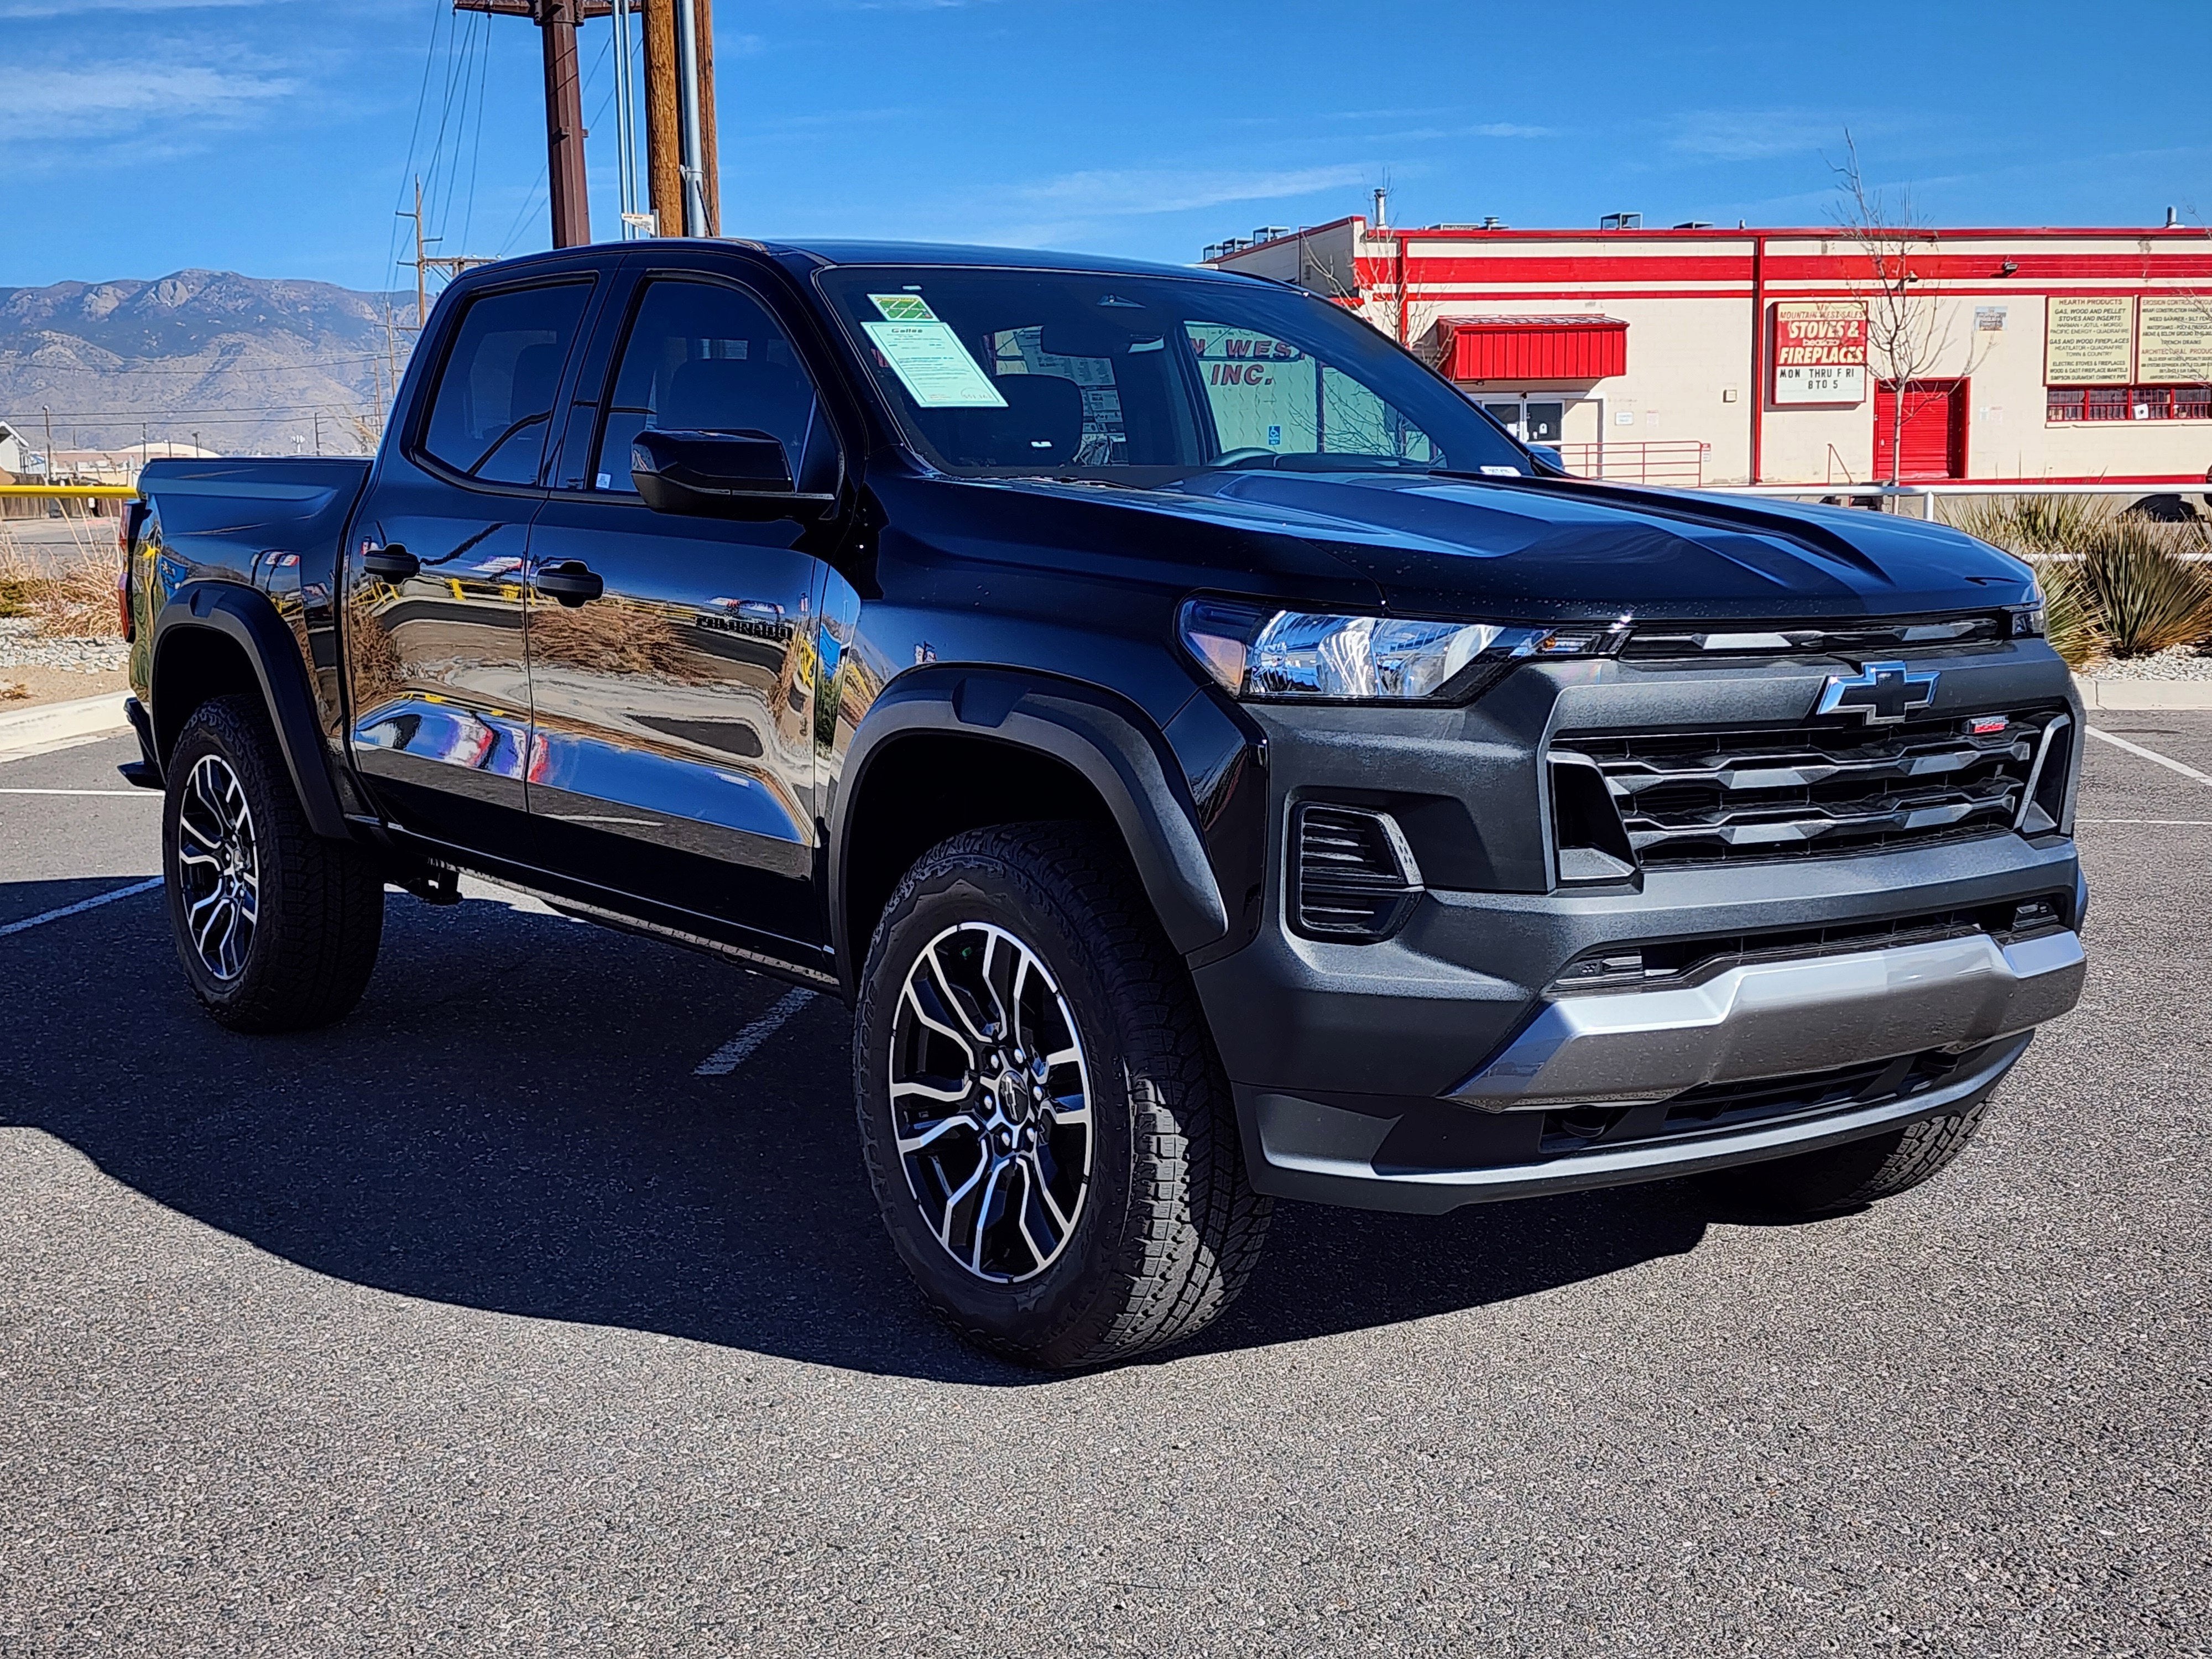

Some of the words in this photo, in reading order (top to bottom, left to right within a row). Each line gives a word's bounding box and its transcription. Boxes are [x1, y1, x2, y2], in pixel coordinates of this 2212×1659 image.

[1788, 321, 1845, 338] STOVES
[1848, 321, 1859, 337] &
[1226, 339, 1305, 359] WES
[1779, 346, 1864, 364] FIREPLACES
[1211, 364, 1273, 385] INC.
[1780, 369, 1801, 378] MON
[1809, 368, 1832, 378] THRU
[1833, 380, 1838, 389] 5
[695, 615, 794, 640] COLORADO
